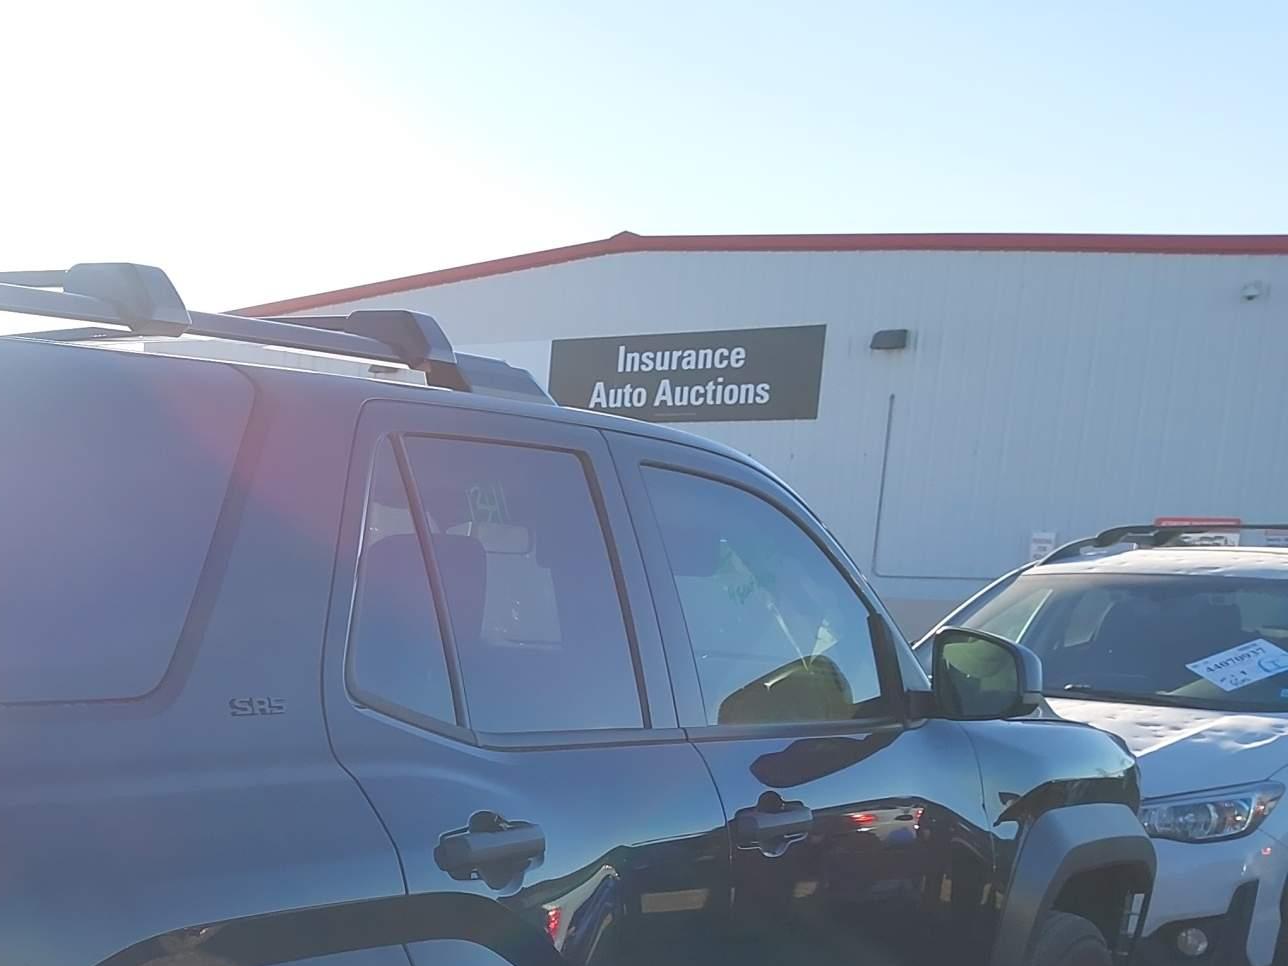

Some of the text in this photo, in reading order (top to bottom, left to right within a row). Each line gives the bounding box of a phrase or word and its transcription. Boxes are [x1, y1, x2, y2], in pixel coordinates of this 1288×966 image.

[616, 345, 746, 372] Insurance
[588, 377, 771, 408] Auto Auctions
[228, 696, 286, 717] SR5
